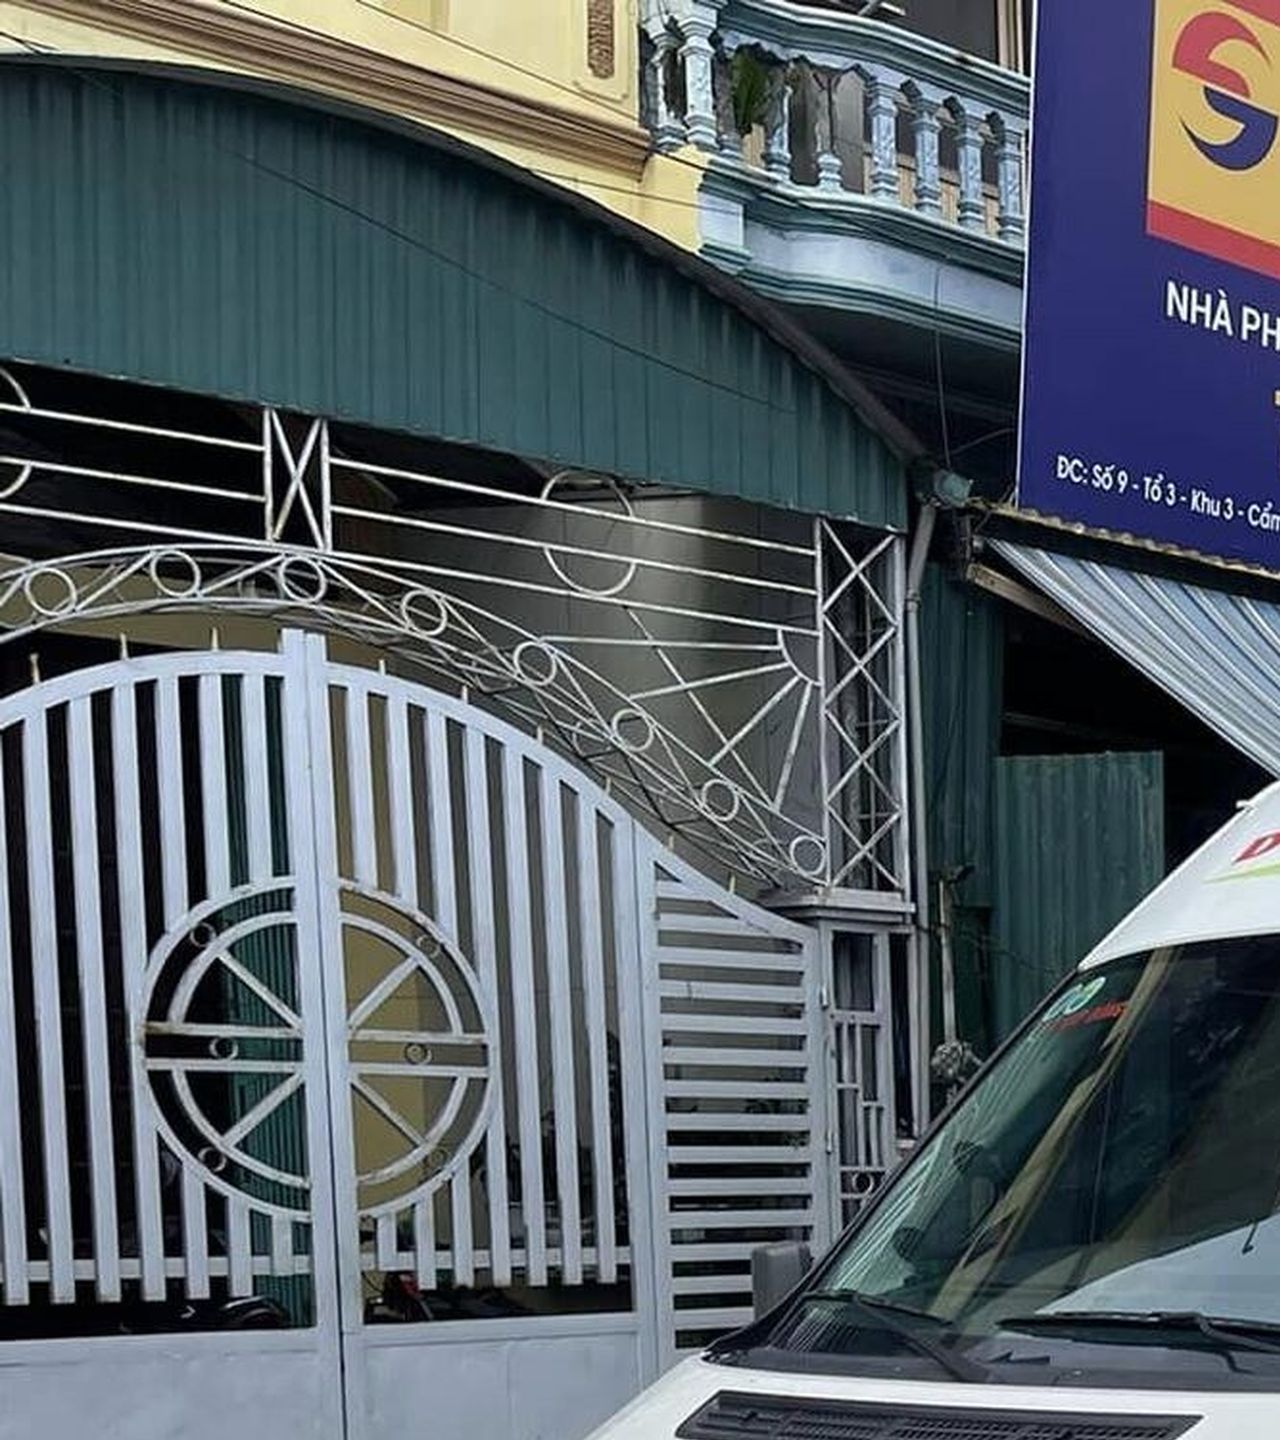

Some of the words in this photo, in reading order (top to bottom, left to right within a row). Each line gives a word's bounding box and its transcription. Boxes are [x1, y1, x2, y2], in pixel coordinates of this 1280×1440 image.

[1167, 280, 1233, 336] NHÀ
[1056, 455, 1088, 483] ĐC:
[1092, 464, 1115, 490] Số
[1117, 470, 1128, 493] 9
[1143, 473, 1164, 502] Tổ
[1165, 482, 1176, 506] 3
[1191, 489, 1220, 517] Khu
[1223, 497, 1234, 520] 3
